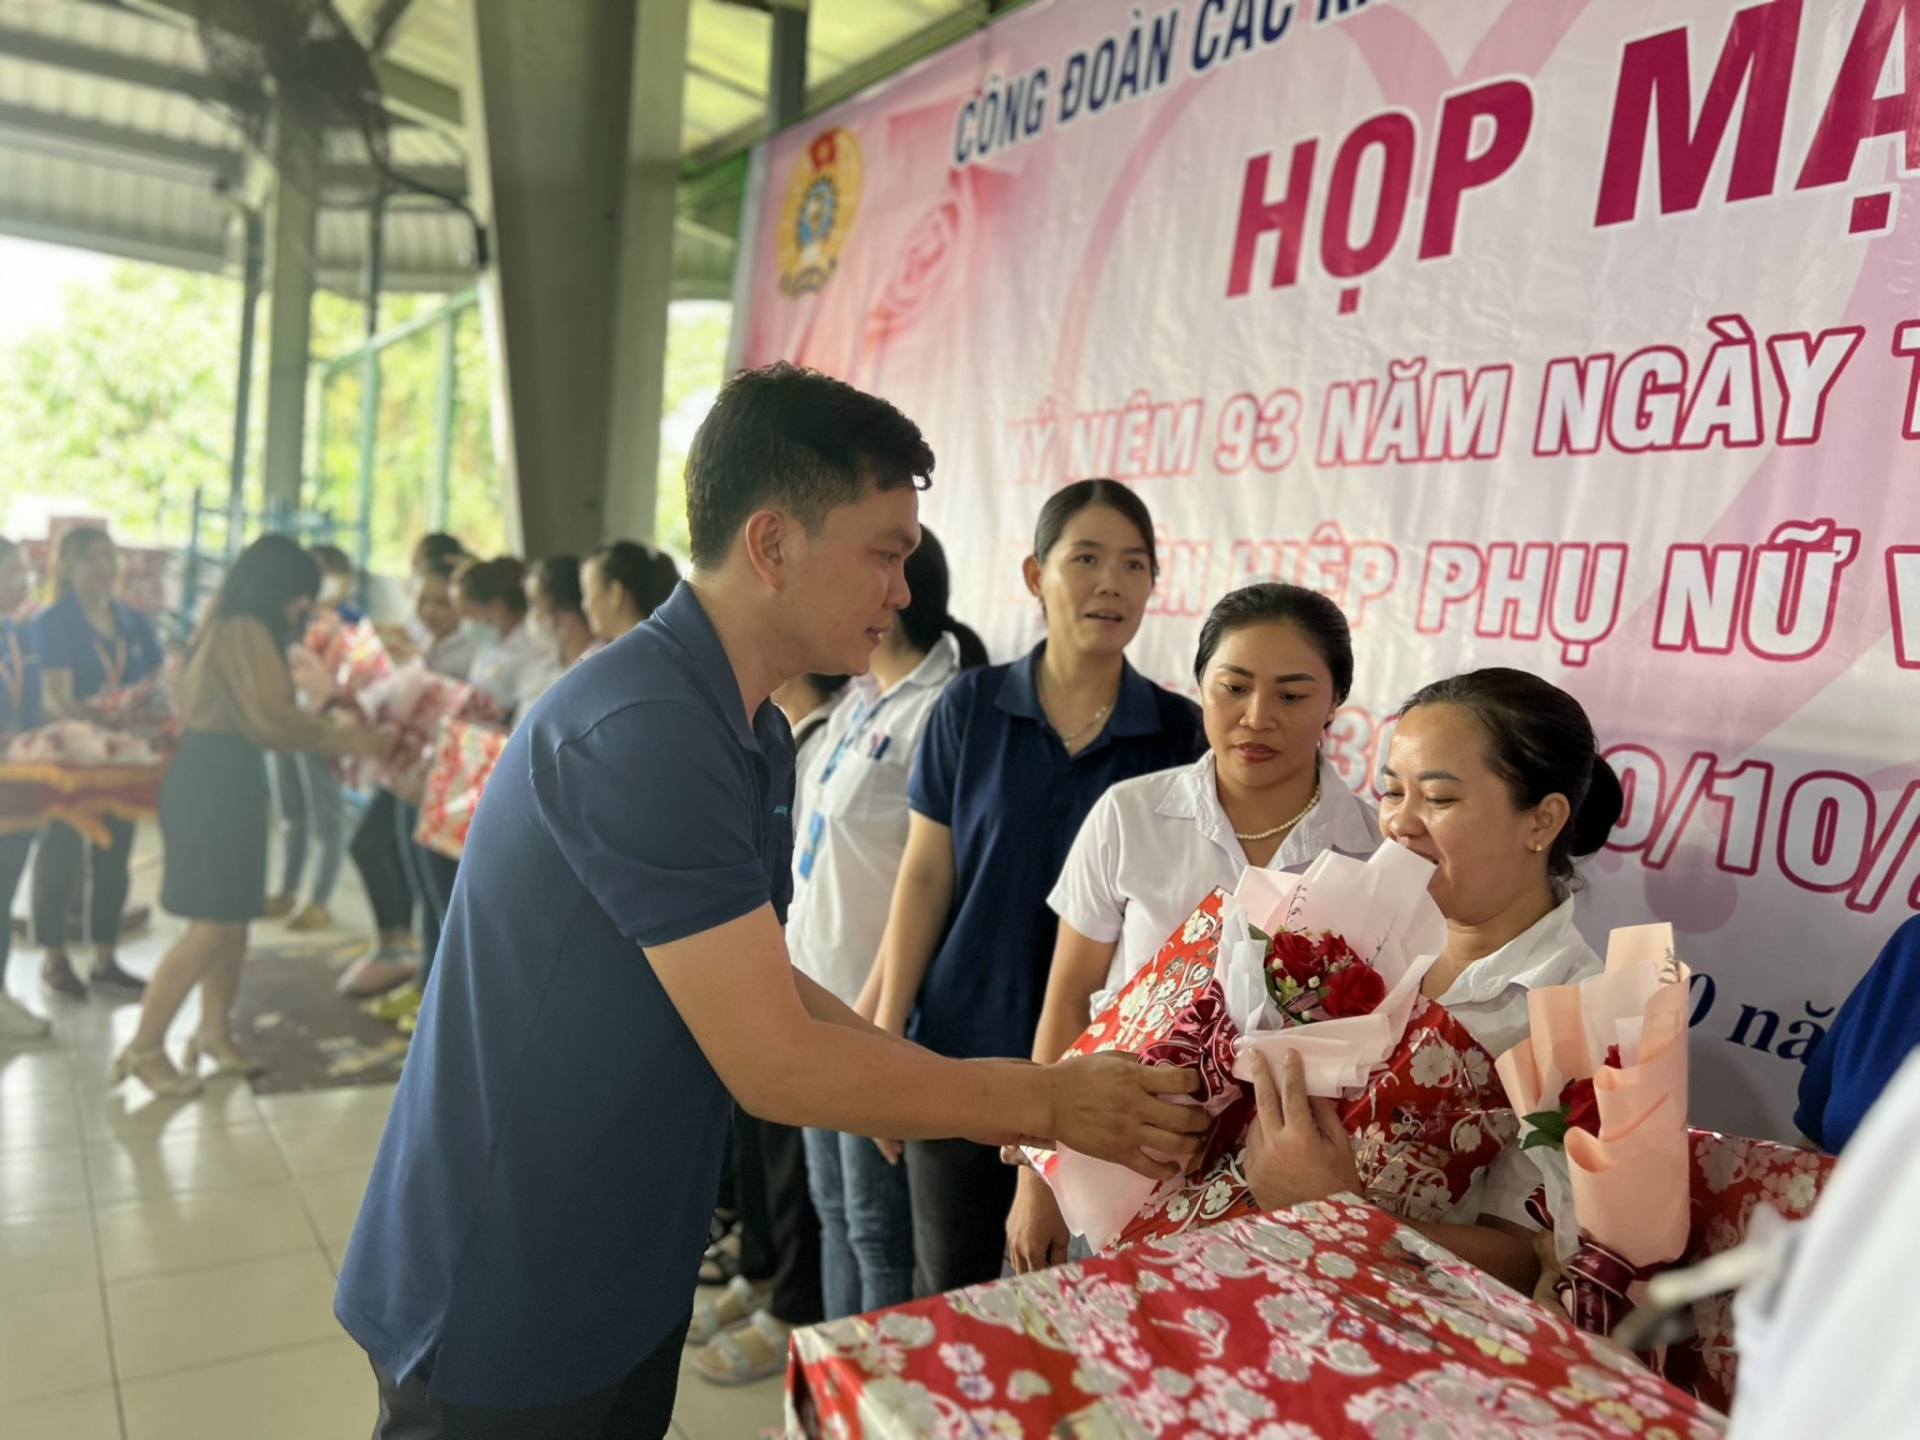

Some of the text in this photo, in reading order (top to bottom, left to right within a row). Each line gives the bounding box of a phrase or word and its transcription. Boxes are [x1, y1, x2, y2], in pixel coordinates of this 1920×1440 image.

[956, 69, 1048, 163] CÔNG
[1059, 10, 1178, 122] ĐOÀN
[1226, 0, 1920, 314] HỌP MẠ
[1214, 388, 1302, 474] 93
[1316, 356, 1513, 468] NĂM
[1533, 314, 1866, 457] NGÀY
[1416, 541, 1628, 667] PHỤ
[1652, 518, 1861, 662] NỮ
[1600, 743, 1920, 914] 0/10/
[1725, 1000, 1835, 1066] nă
